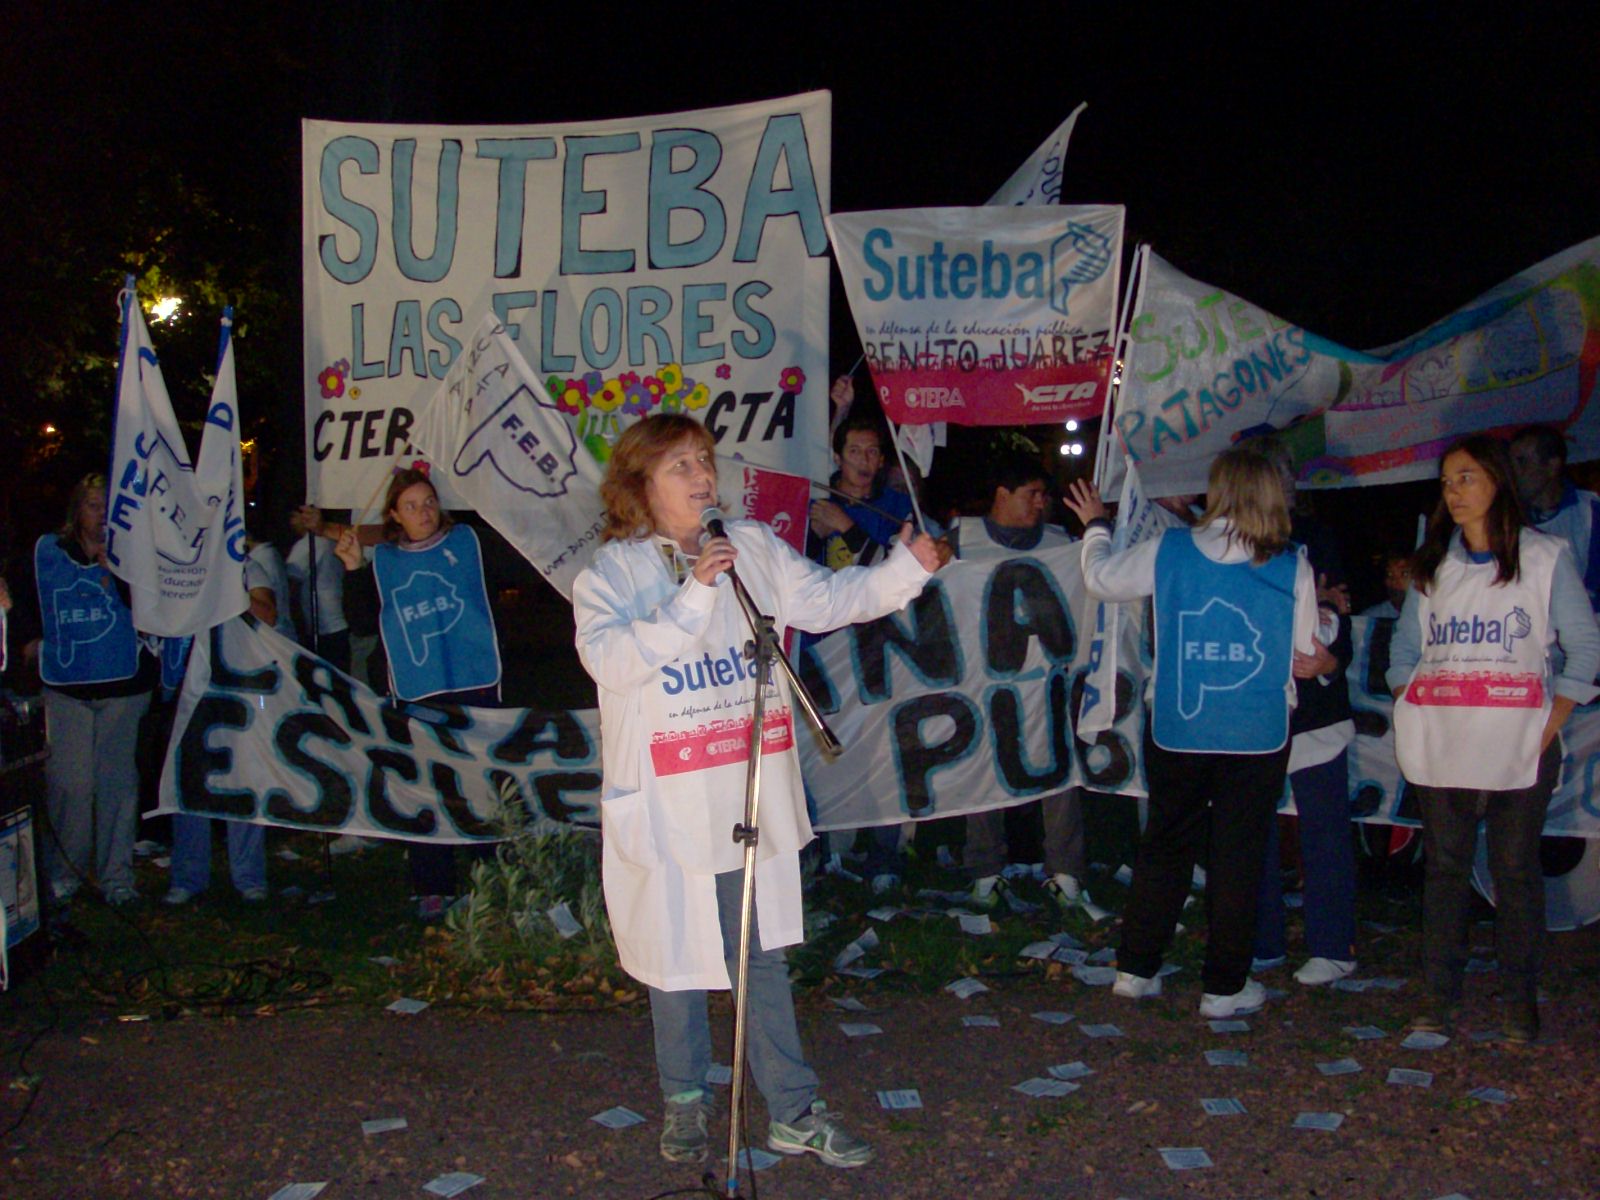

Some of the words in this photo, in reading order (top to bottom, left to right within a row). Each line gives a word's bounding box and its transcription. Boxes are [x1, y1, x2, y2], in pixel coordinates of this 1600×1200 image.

[318, 113, 830, 284] SUTEBA
[862, 227, 1044, 301] Suteba
[351, 298, 463, 380] LAS
[493, 281, 776, 374] FLORES
[865, 336, 979, 375] BENITO
[992, 329, 1110, 373] JUAREZ
[879, 320, 921, 342] defensa
[925, 318, 940, 334] de
[943, 320, 958, 334] la
[963, 321, 1031, 335] educación
[1130, 290, 1290, 383] SUTE
[314, 407, 424, 462] CTER
[704, 391, 798, 445] CTA
[1116, 326, 1311, 464] PATAGONES
[502, 413, 559, 483] F.E.B.
[59, 607, 108, 625] F.E.B.
[402, 596, 455, 622] F.E.B.
[1427, 612, 1501, 646] Suteba
[1185, 641, 1253, 662] F.E.B.
[713, 702, 722, 710] de
[724, 699, 732, 709] la
[177, 690, 603, 840] ESCUE
[890, 665, 1139, 817] PUB
